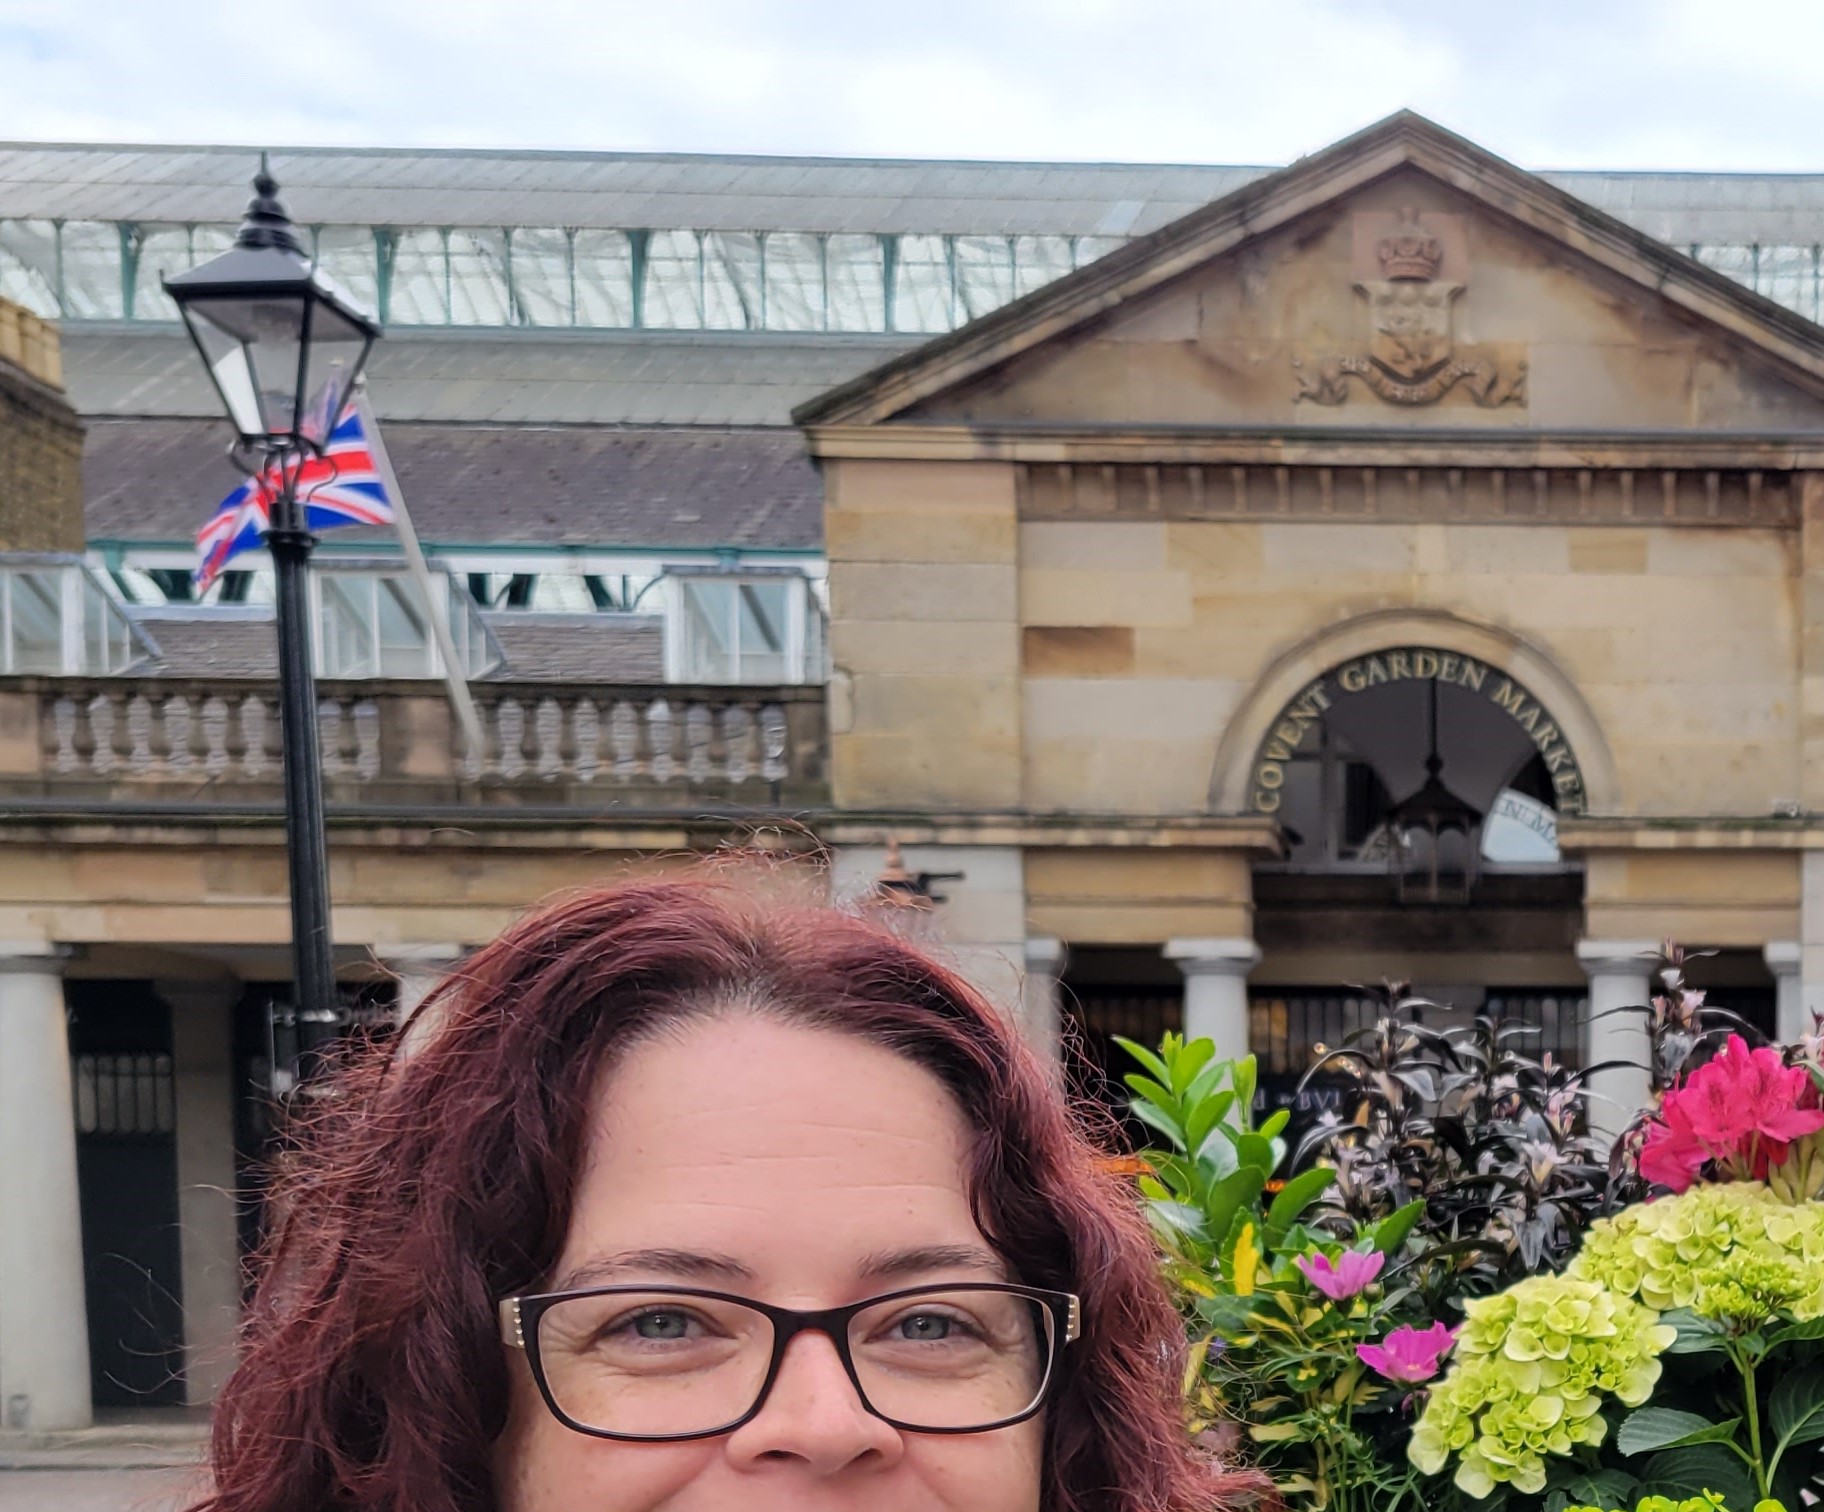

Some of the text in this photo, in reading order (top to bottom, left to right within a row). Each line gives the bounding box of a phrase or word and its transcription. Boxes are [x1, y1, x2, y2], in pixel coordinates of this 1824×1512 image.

[1255, 650, 1583, 815] COVENT GARDEN MARKET
